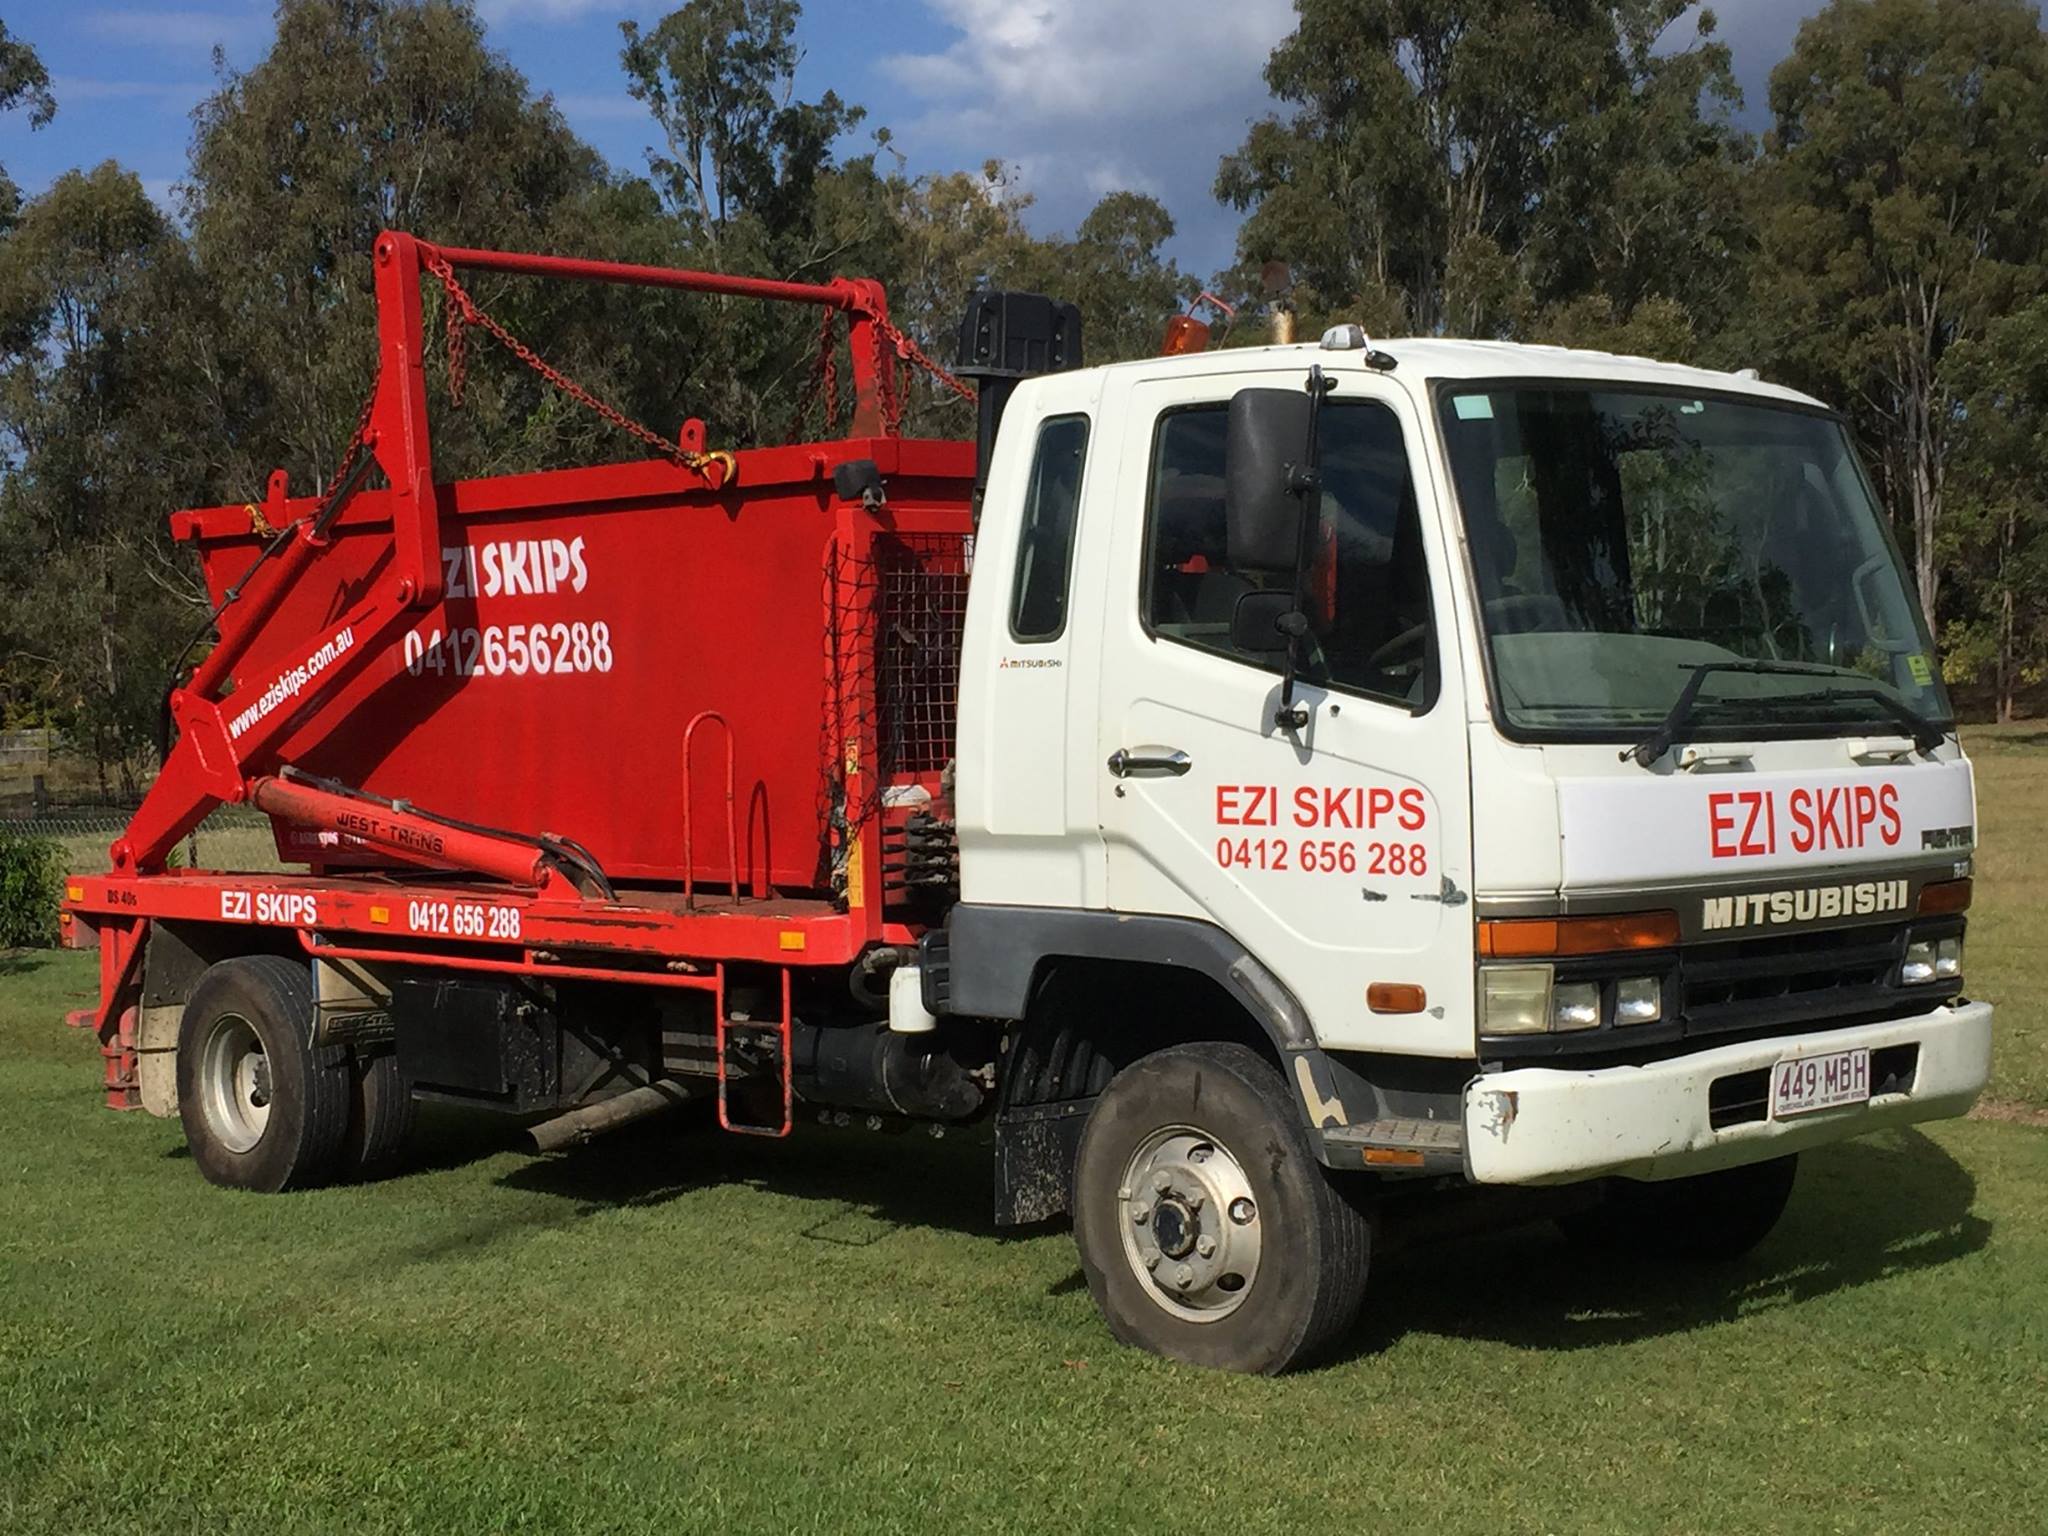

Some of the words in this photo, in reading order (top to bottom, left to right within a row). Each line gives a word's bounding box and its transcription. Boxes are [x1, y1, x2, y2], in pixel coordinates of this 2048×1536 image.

[442, 545, 479, 599] ZI
[482, 535, 588, 598] SKIPS
[404, 621, 613, 677] 0412656288
[229, 626, 354, 739] www.eziskips.com.au
[1216, 785, 1277, 826] EZI
[1293, 786, 1426, 831] SKIPS
[1709, 791, 1775, 858] EZI
[1789, 783, 1901, 853] SKIPS
[1217, 837, 1288, 871] 0412
[1300, 840, 1356, 873] 656
[1368, 842, 1427, 876] 288
[221, 890, 250, 920] EZI
[256, 893, 317, 925] SKIPS
[408, 900, 449, 934] 0412
[453, 903, 485, 936] 656
[488, 906, 521, 939] 288
[1702, 880, 1909, 931] MITSUBISHI
